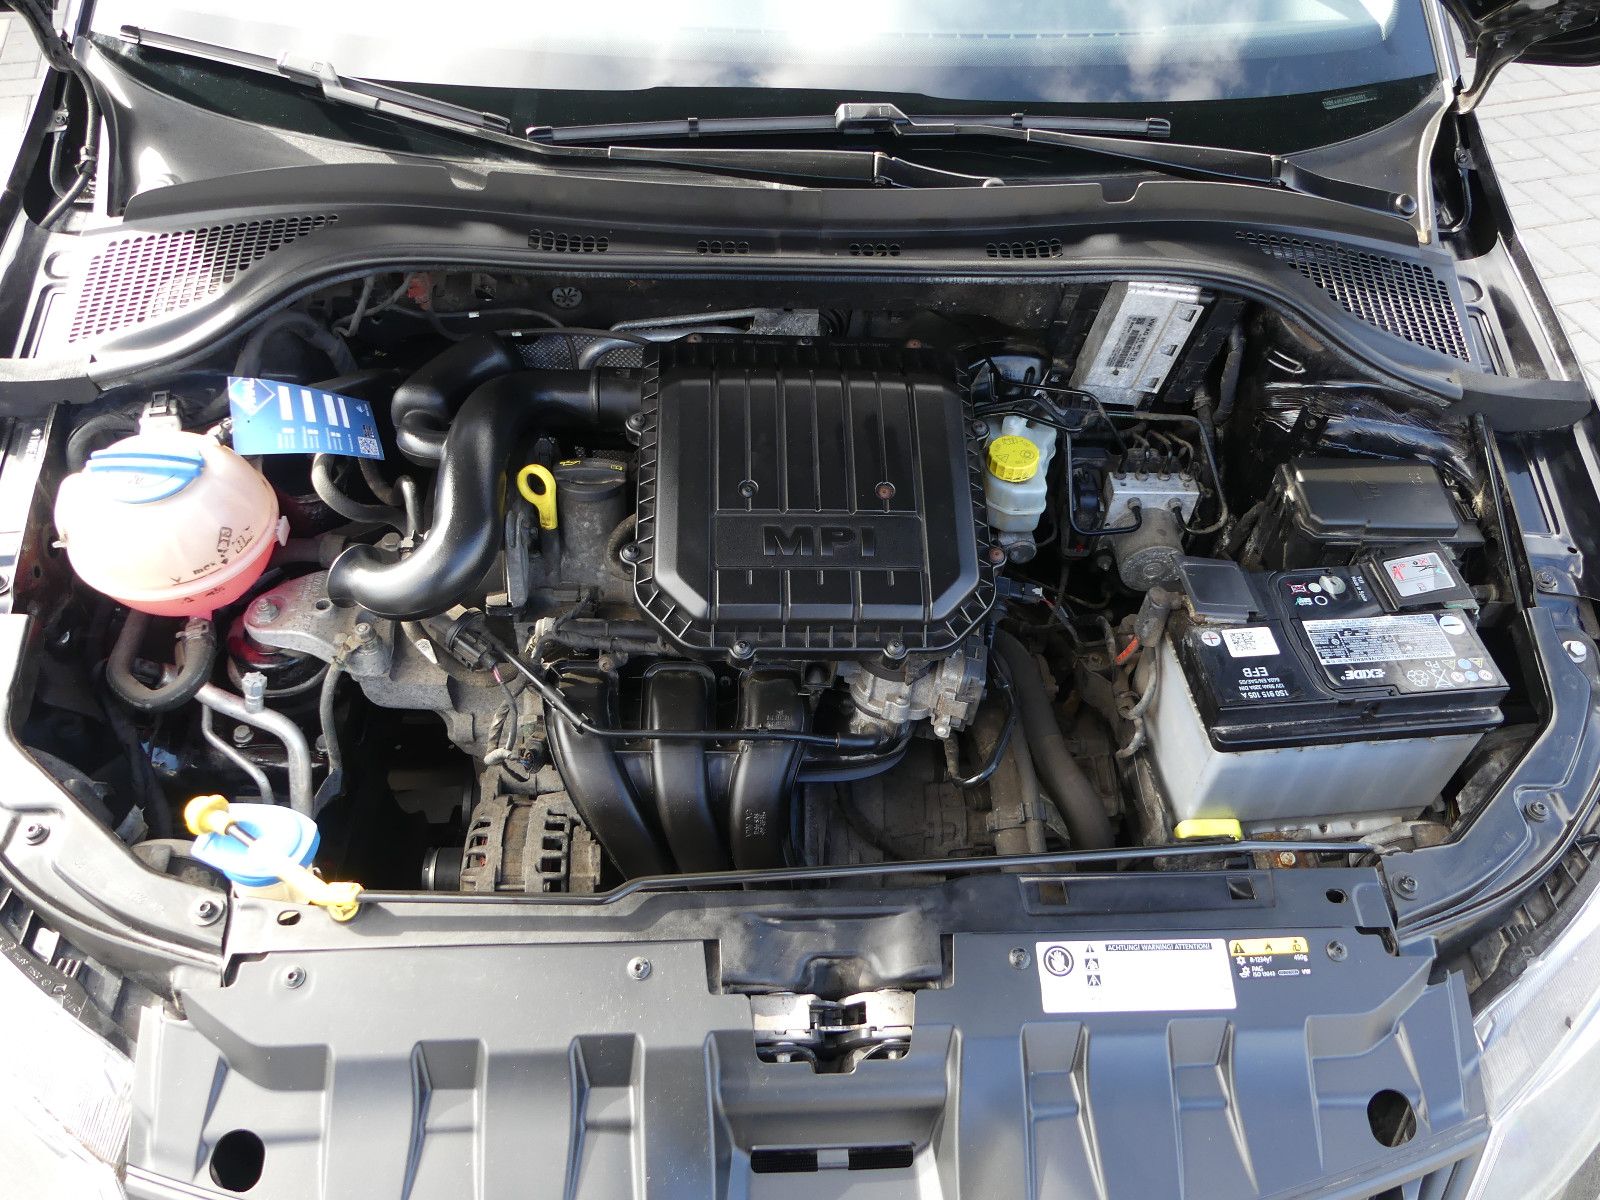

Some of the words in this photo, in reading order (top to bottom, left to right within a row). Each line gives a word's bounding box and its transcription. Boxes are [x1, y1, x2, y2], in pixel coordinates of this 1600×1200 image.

[763, 525, 875, 557] MPI
[1425, 660, 1439, 669] Pb
[1242, 666, 1269, 678] EFB
[1344, 669, 1385, 680] EXIDE
[1247, 691, 1261, 699] 105
[1141, 943, 1173, 951] WARNING!
[1174, 942, 1210, 950] ATTENTION!
